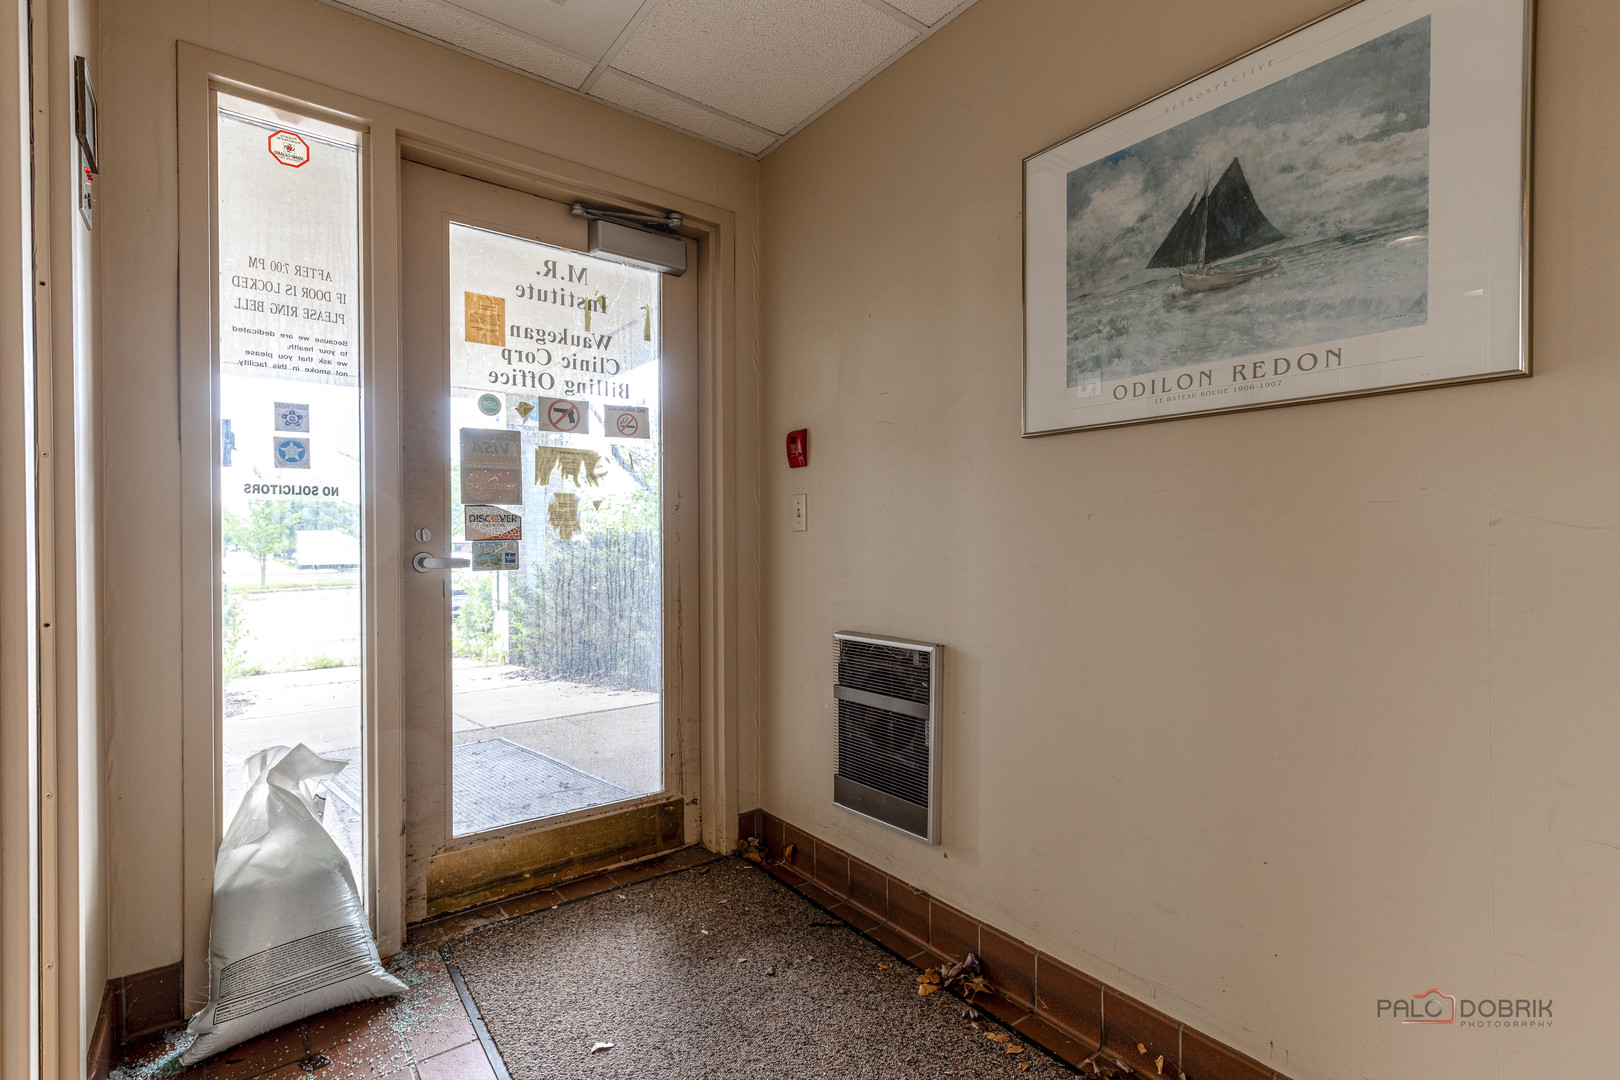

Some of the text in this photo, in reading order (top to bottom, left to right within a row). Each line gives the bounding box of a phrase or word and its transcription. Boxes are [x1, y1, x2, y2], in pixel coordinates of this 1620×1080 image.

[1164, 59, 1275, 114] RETROSPECTIVE
[1113, 348, 1342, 400] ODILON REDON
[1166, 392, 1197, 402] BATEAU
[1200, 388, 1229, 397] ROUGE
[1233, 380, 1282, 393] 1906-1907
[468, 514, 517, 523] DISCOVER
